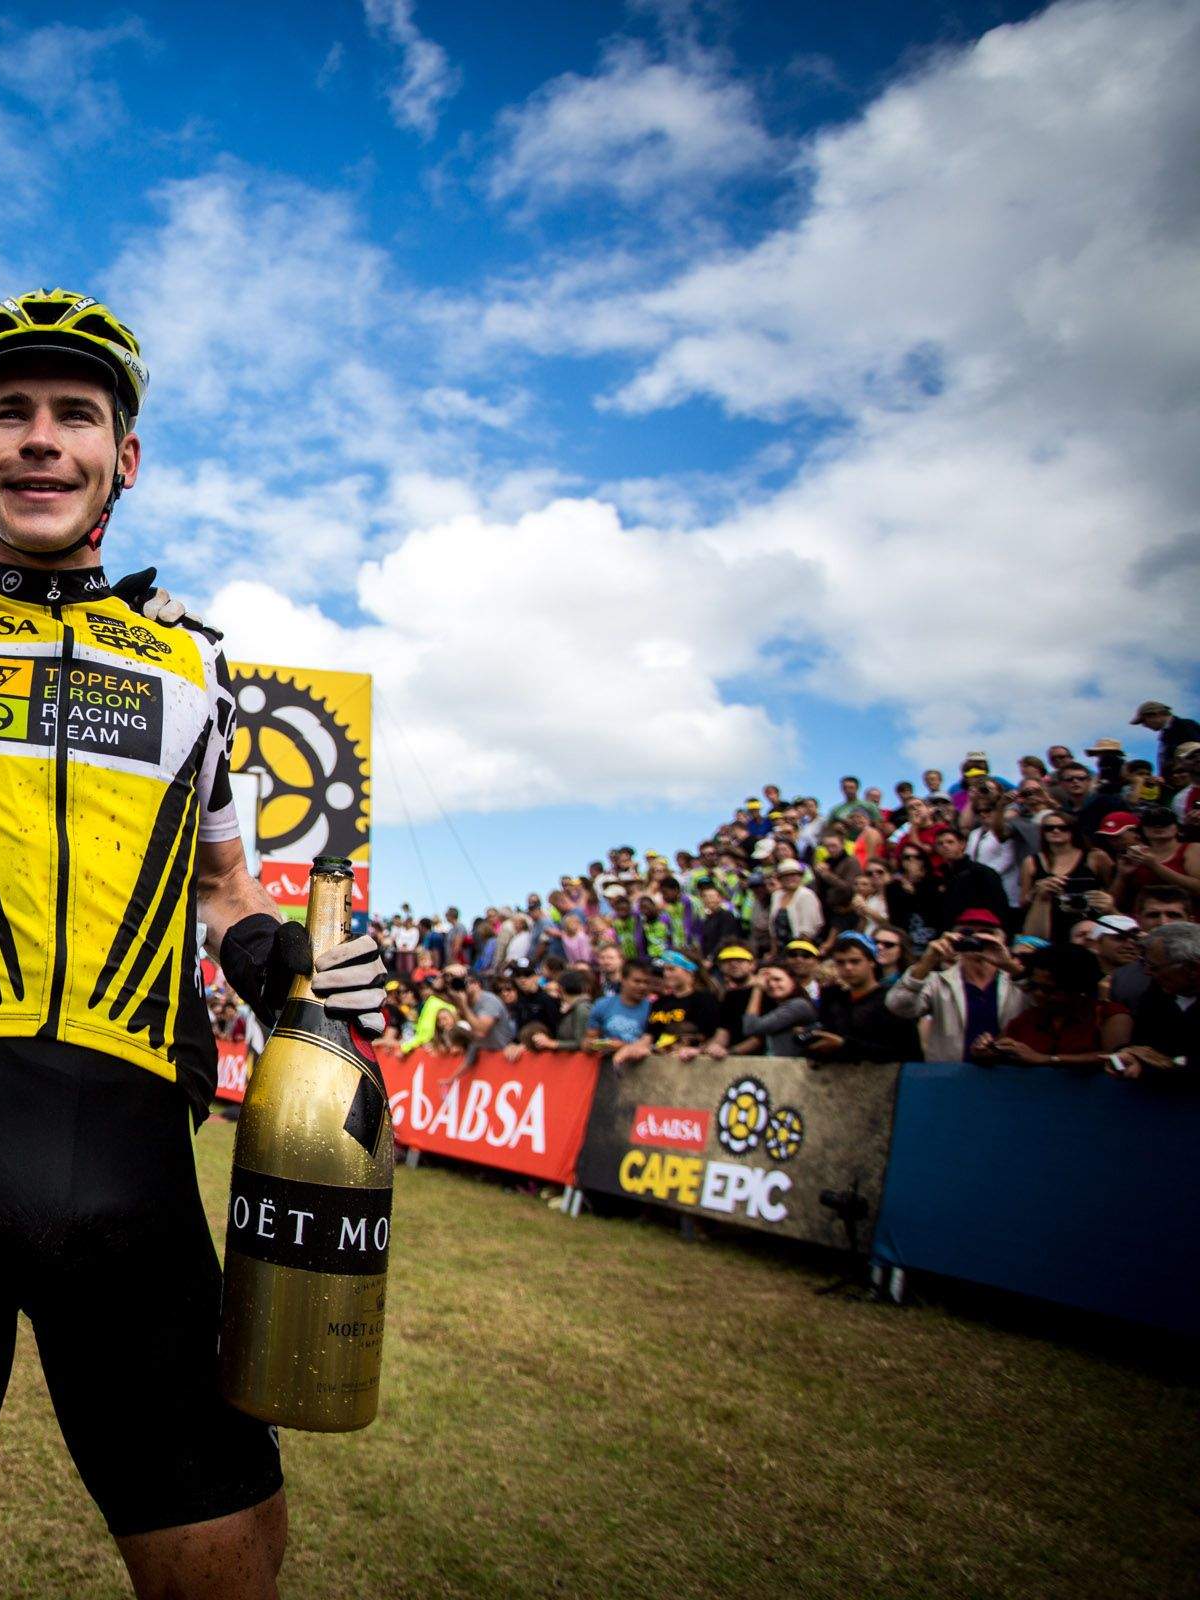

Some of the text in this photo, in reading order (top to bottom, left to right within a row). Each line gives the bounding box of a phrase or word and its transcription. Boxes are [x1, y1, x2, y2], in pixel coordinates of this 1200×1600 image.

[89, 623, 132, 638] CAPE
[91, 632, 163, 662] EPIC
[45, 667, 152, 697] TOPEAK
[43, 685, 141, 711] ERGON
[41, 703, 148, 731] RACING
[40, 721, 120, 746] TEAM
[427, 1077, 547, 1155] ABSA
[619, 1150, 793, 1222] CAPE EPIC
[337, 1216, 389, 1252] MO
[327, 1321, 368, 1337] MOËT
